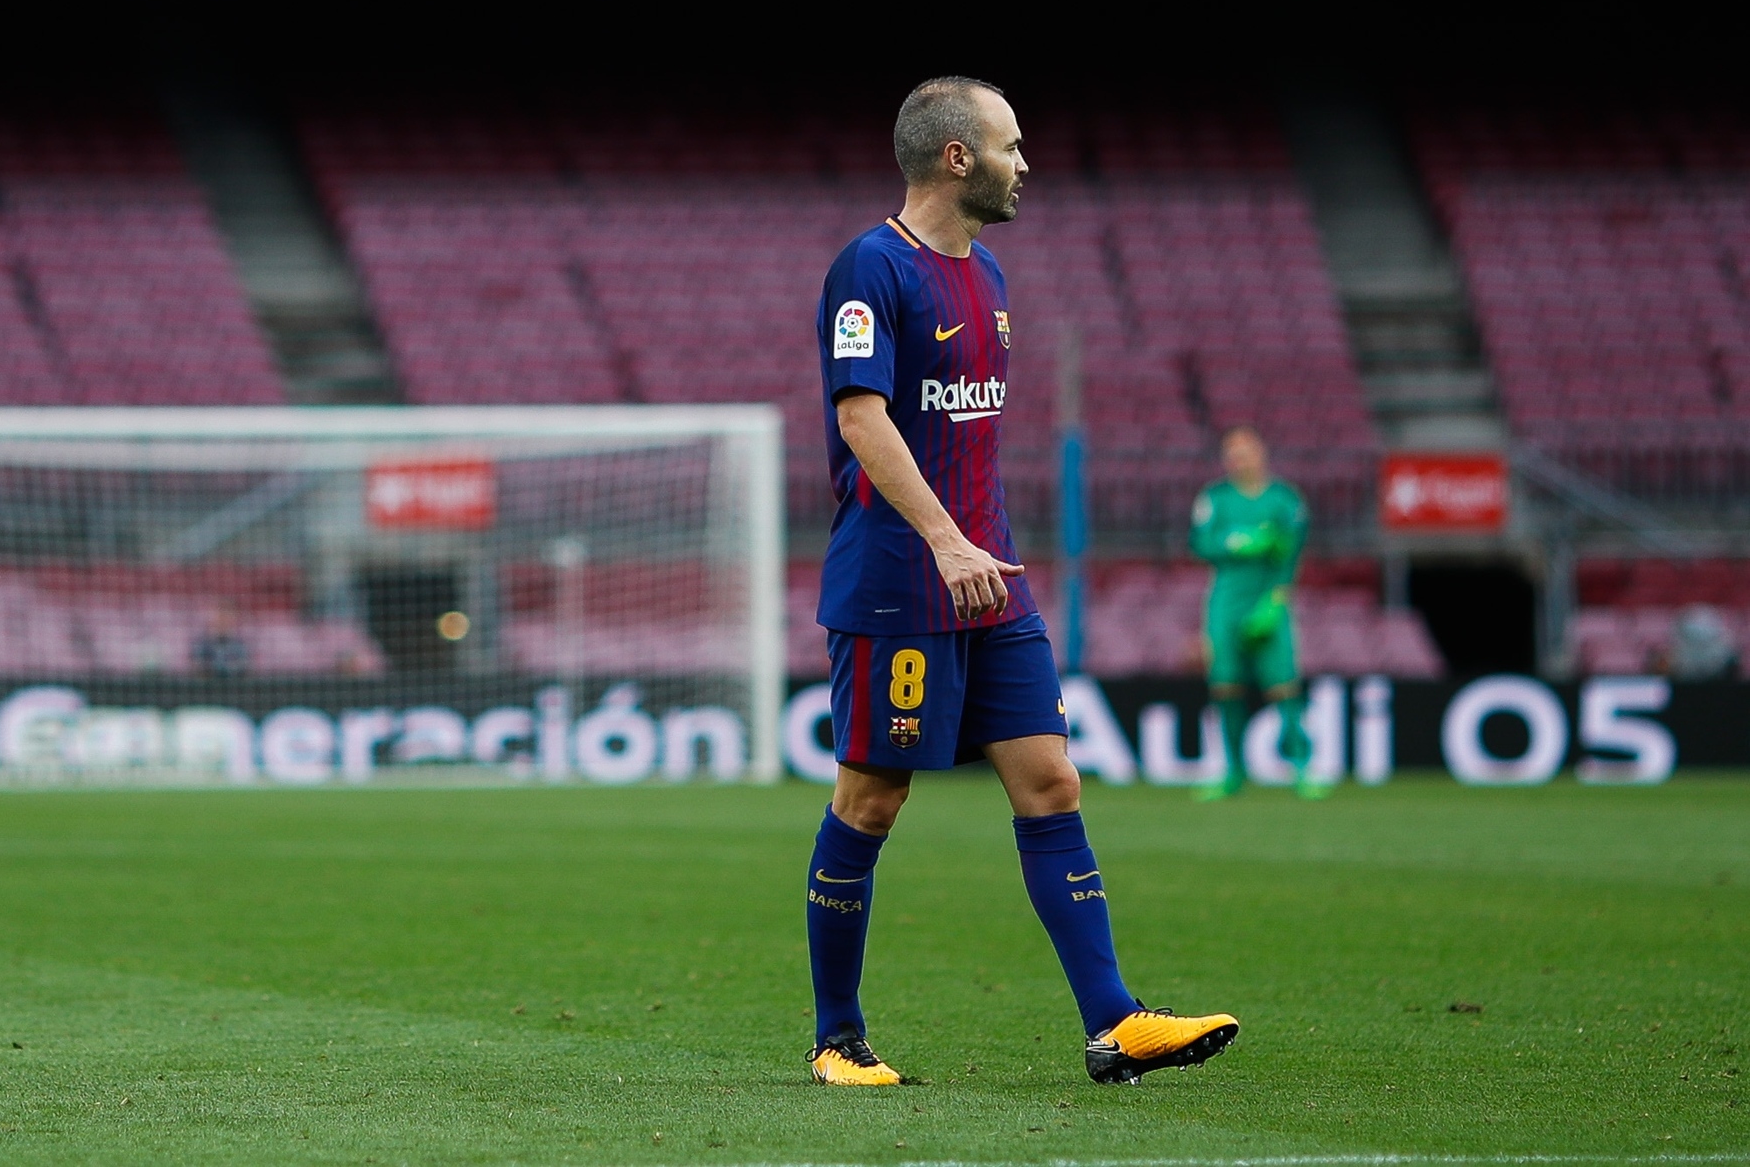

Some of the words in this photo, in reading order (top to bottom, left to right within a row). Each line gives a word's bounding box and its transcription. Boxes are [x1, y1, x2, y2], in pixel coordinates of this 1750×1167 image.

[837, 340, 870, 351] LaLiga
[890, 648, 926, 710] 8
[1060, 675, 1392, 784] Audi
[809, 889, 862, 913] BARÇA
